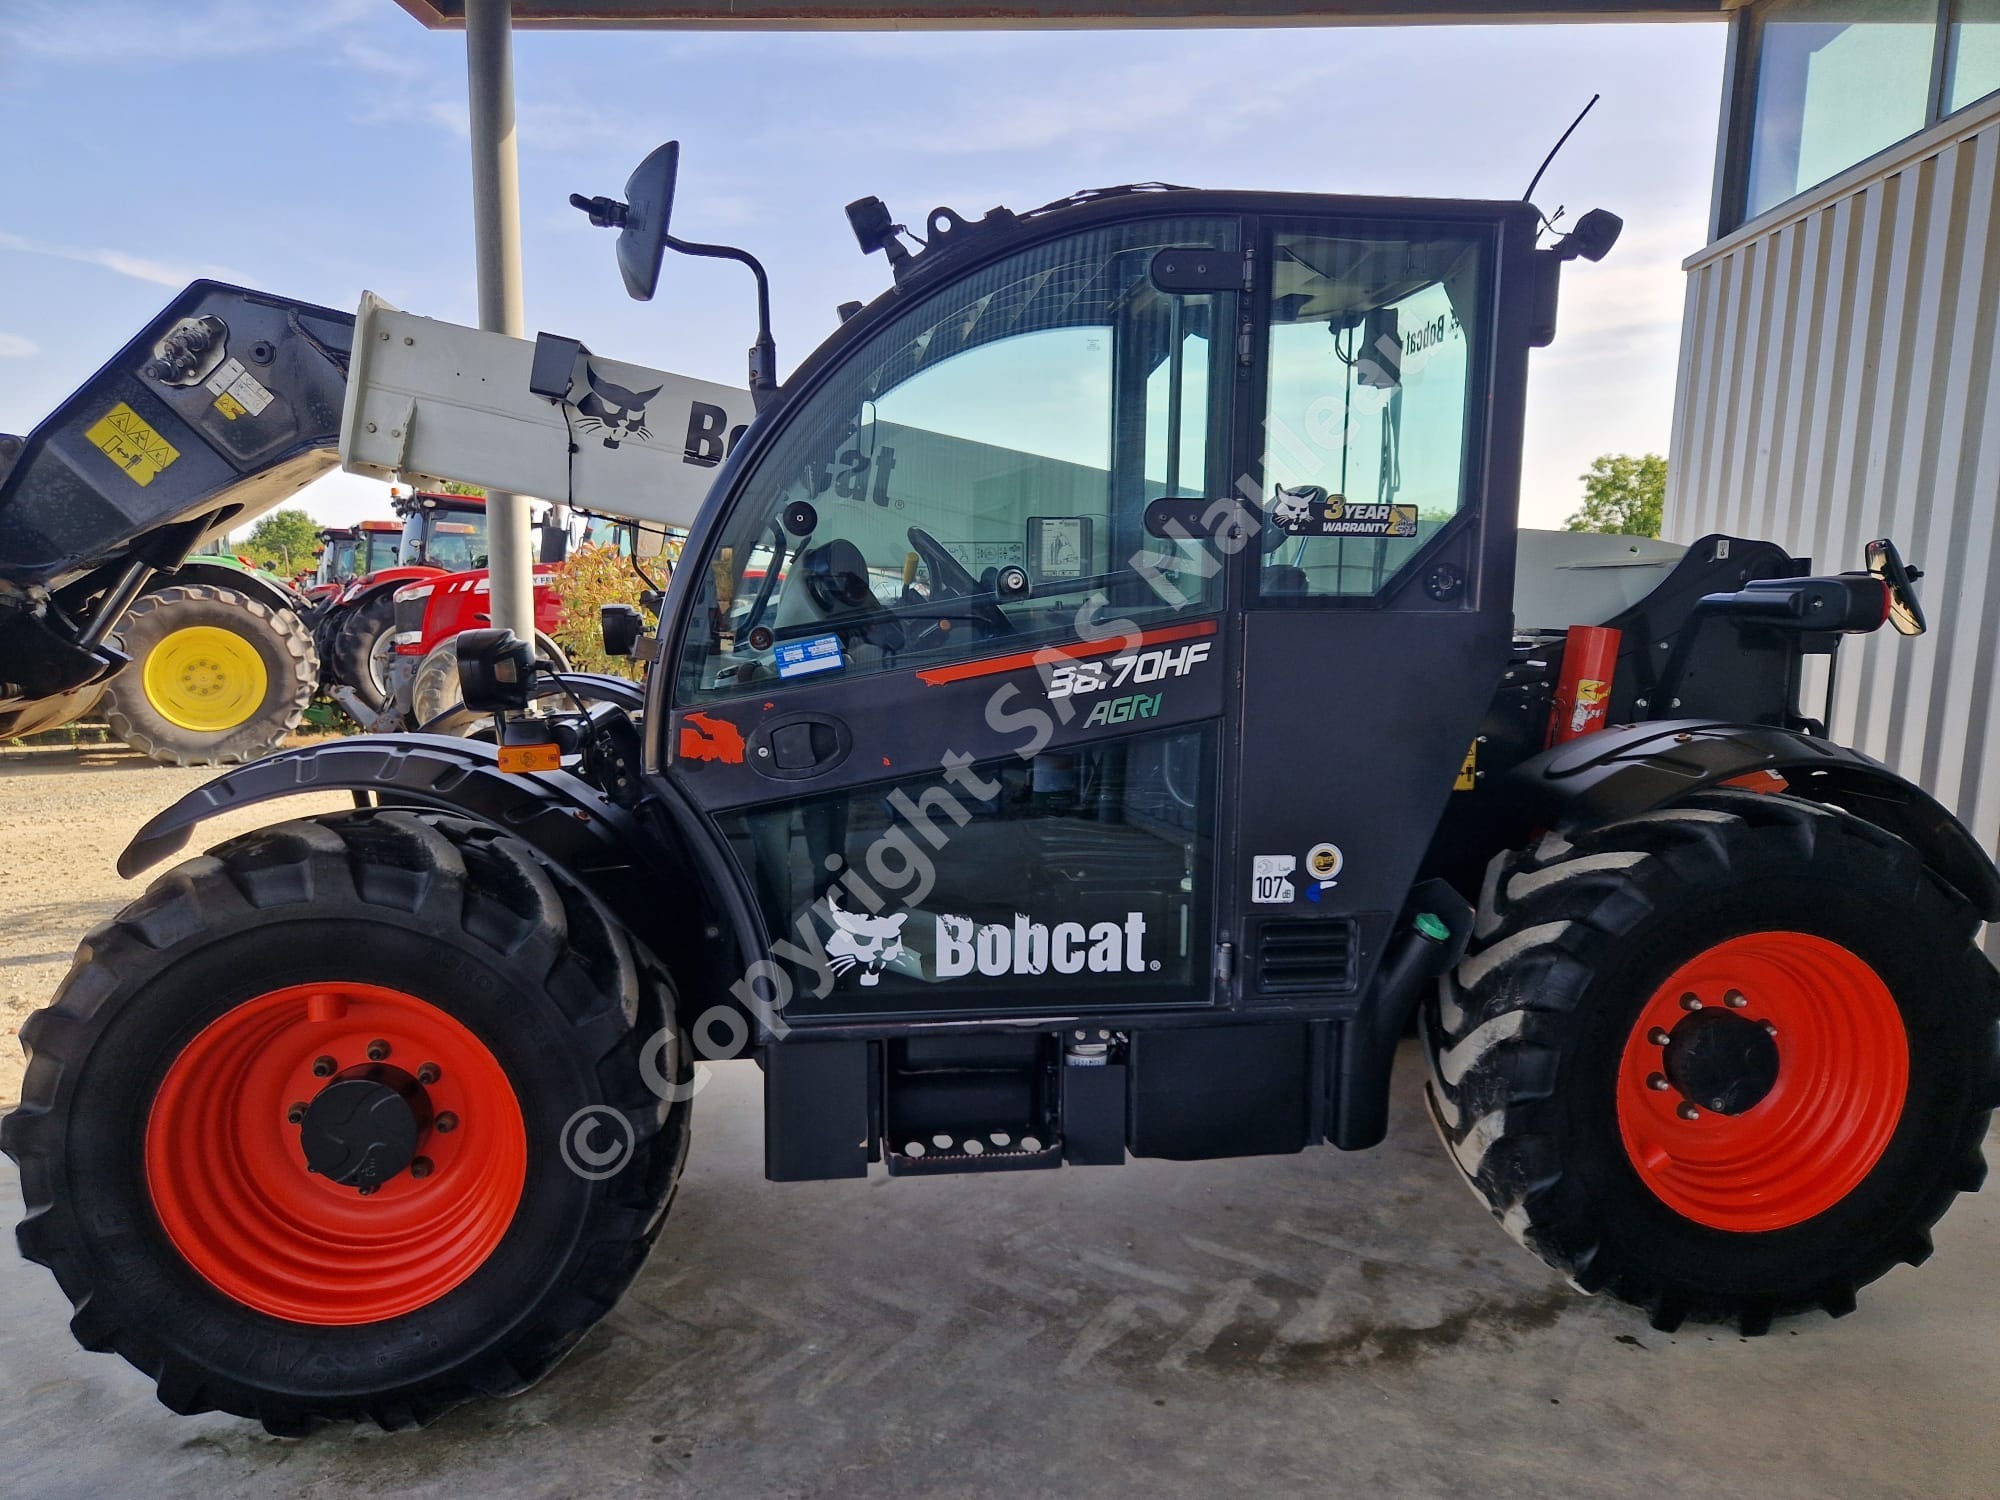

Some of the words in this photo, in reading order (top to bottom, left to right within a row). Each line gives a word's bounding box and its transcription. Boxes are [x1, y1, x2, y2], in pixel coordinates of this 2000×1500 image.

[1323, 494, 1347, 520] 3
[1344, 505, 1390, 520] YEAR
[1322, 521, 1390, 533] WARRANTY
[1082, 691, 1164, 729] AGRI
[1255, 875, 1284, 899] 107
[1281, 889, 1292, 899] dB
[935, 911, 1146, 977] Bobcat
